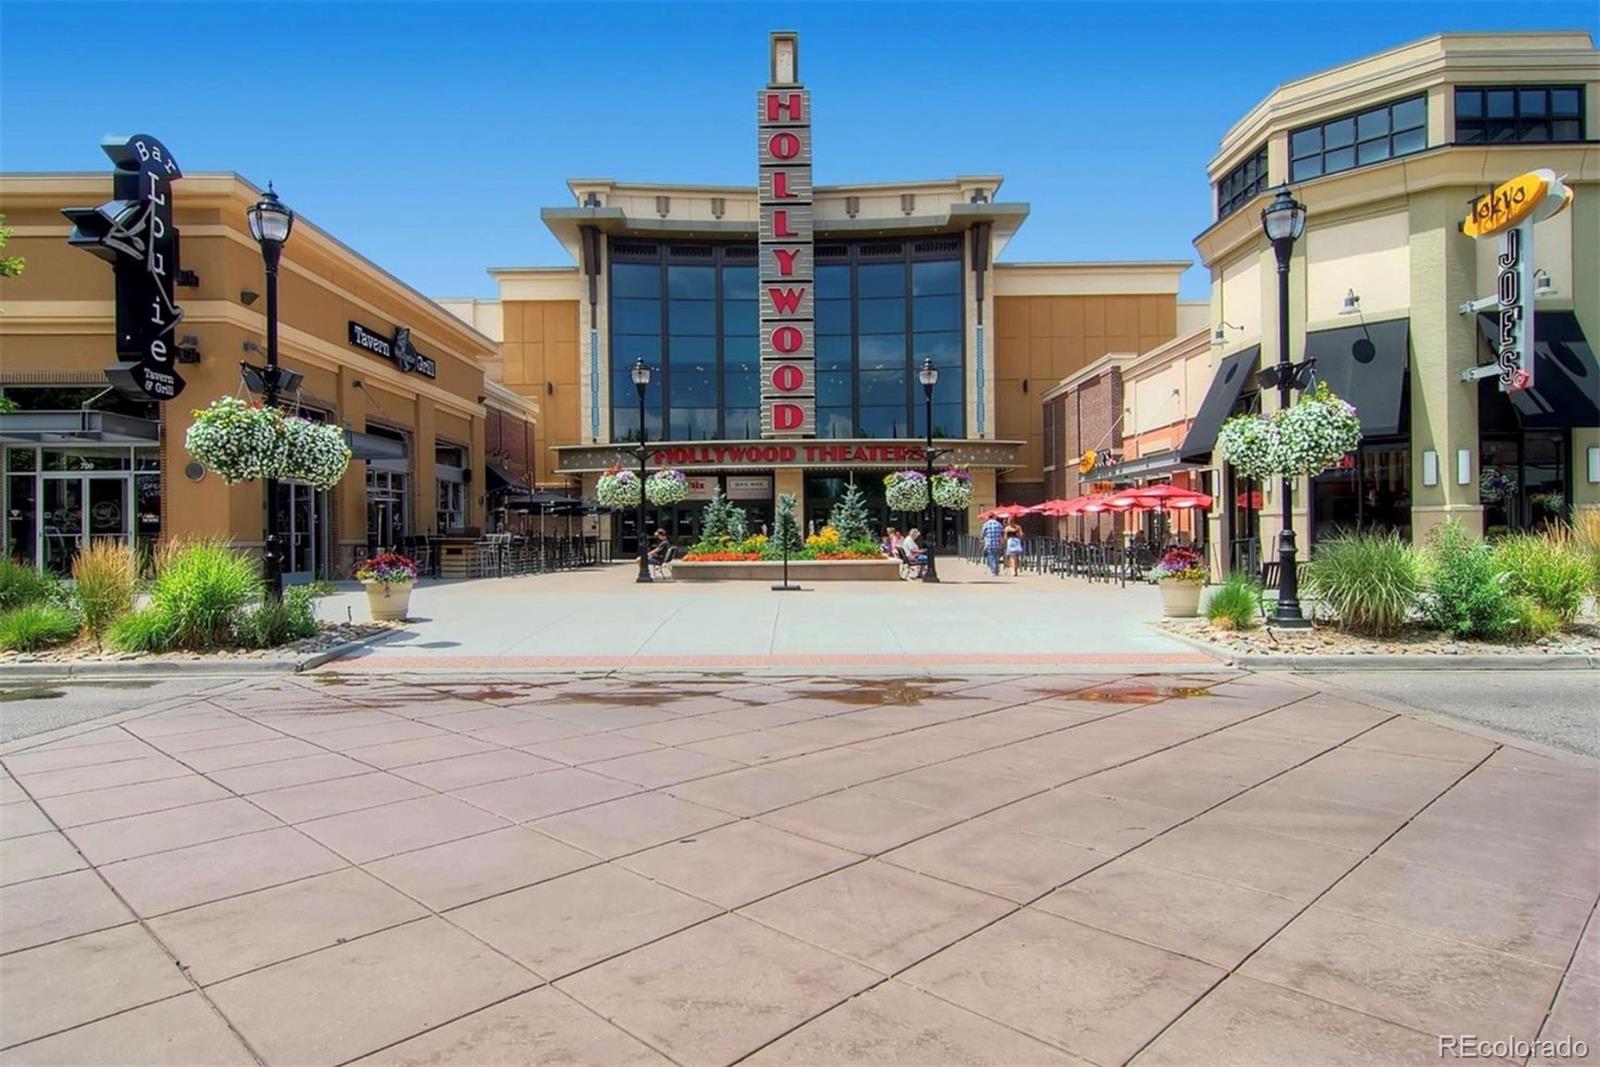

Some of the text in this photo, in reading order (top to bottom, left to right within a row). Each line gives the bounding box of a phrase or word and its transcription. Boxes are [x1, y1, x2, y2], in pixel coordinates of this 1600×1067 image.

[135, 141, 177, 174] Bar
[1466, 184, 1526, 225] Tokyo
[147, 171, 167, 361] Louie
[765, 93, 806, 431] HOLLYWOOD
[354, 325, 435, 377] Tavern Grill
[143, 367, 175, 384] Tavern
[145, 380, 175, 395] & Grill
[654, 445, 926, 465] HOLLYWOOD THEATERS
